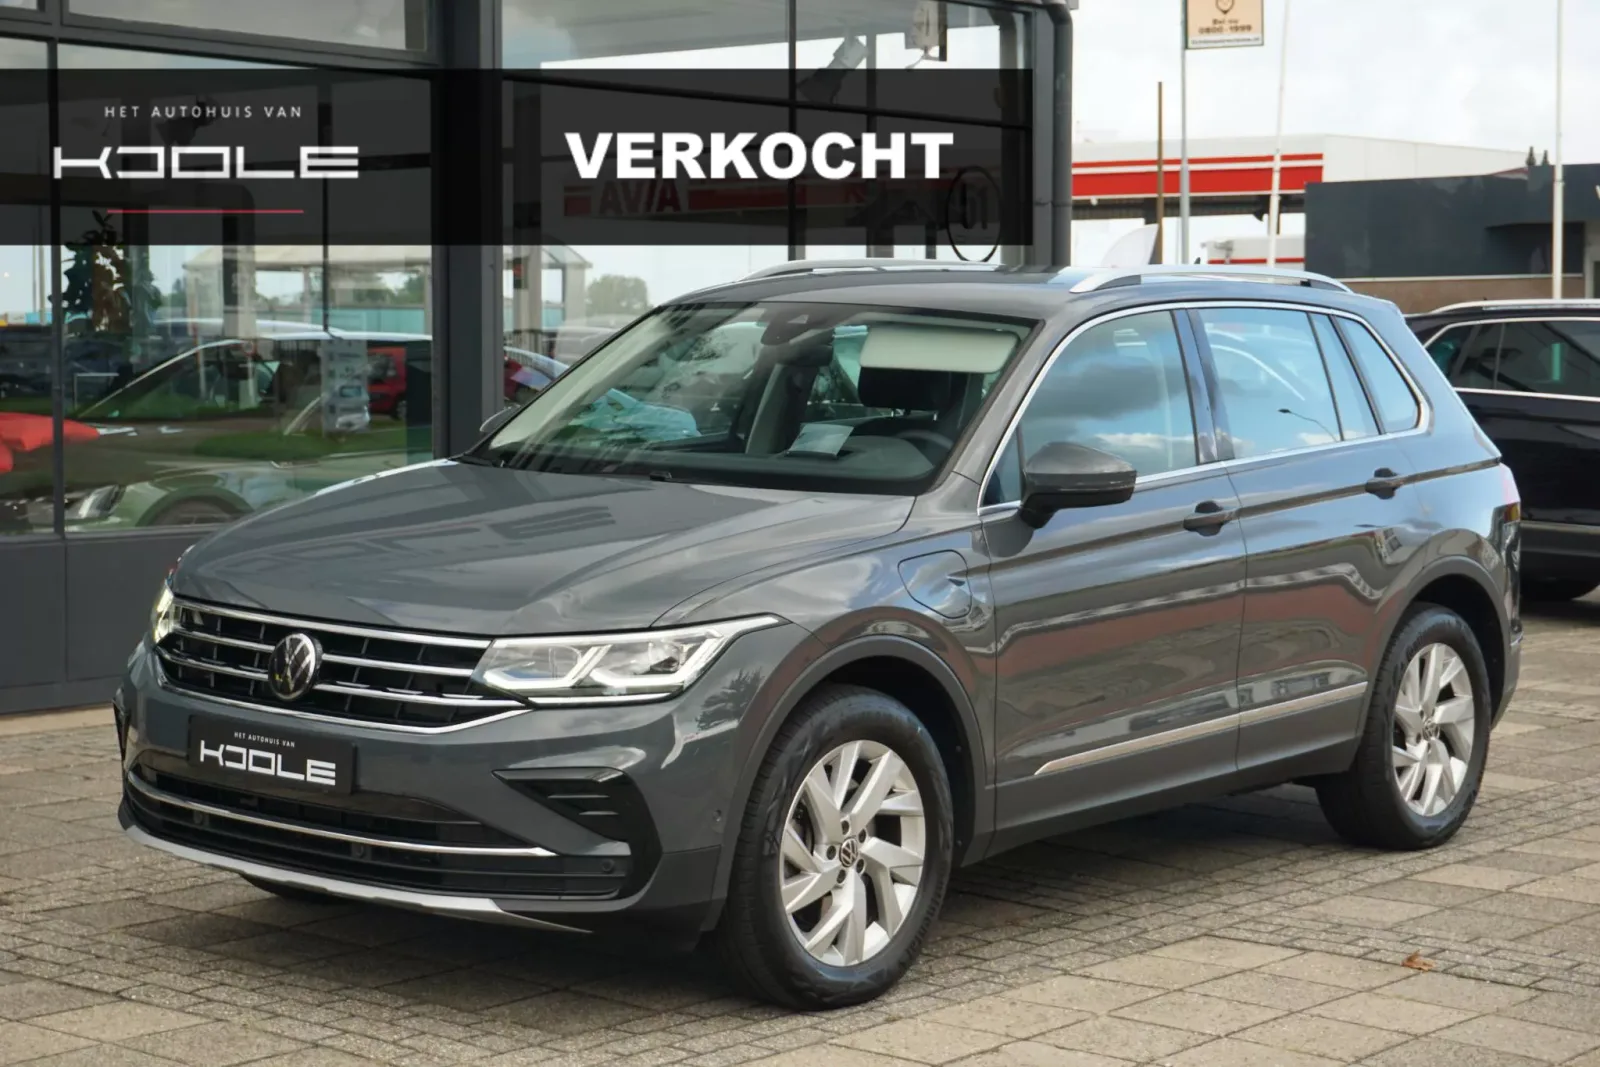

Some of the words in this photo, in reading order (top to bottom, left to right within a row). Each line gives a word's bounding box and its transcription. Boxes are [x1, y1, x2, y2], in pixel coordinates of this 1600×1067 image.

[234, 732, 246, 740] HET
[248, 734, 280, 746] AUTOHUIS
[282, 740, 296, 748] VAN
